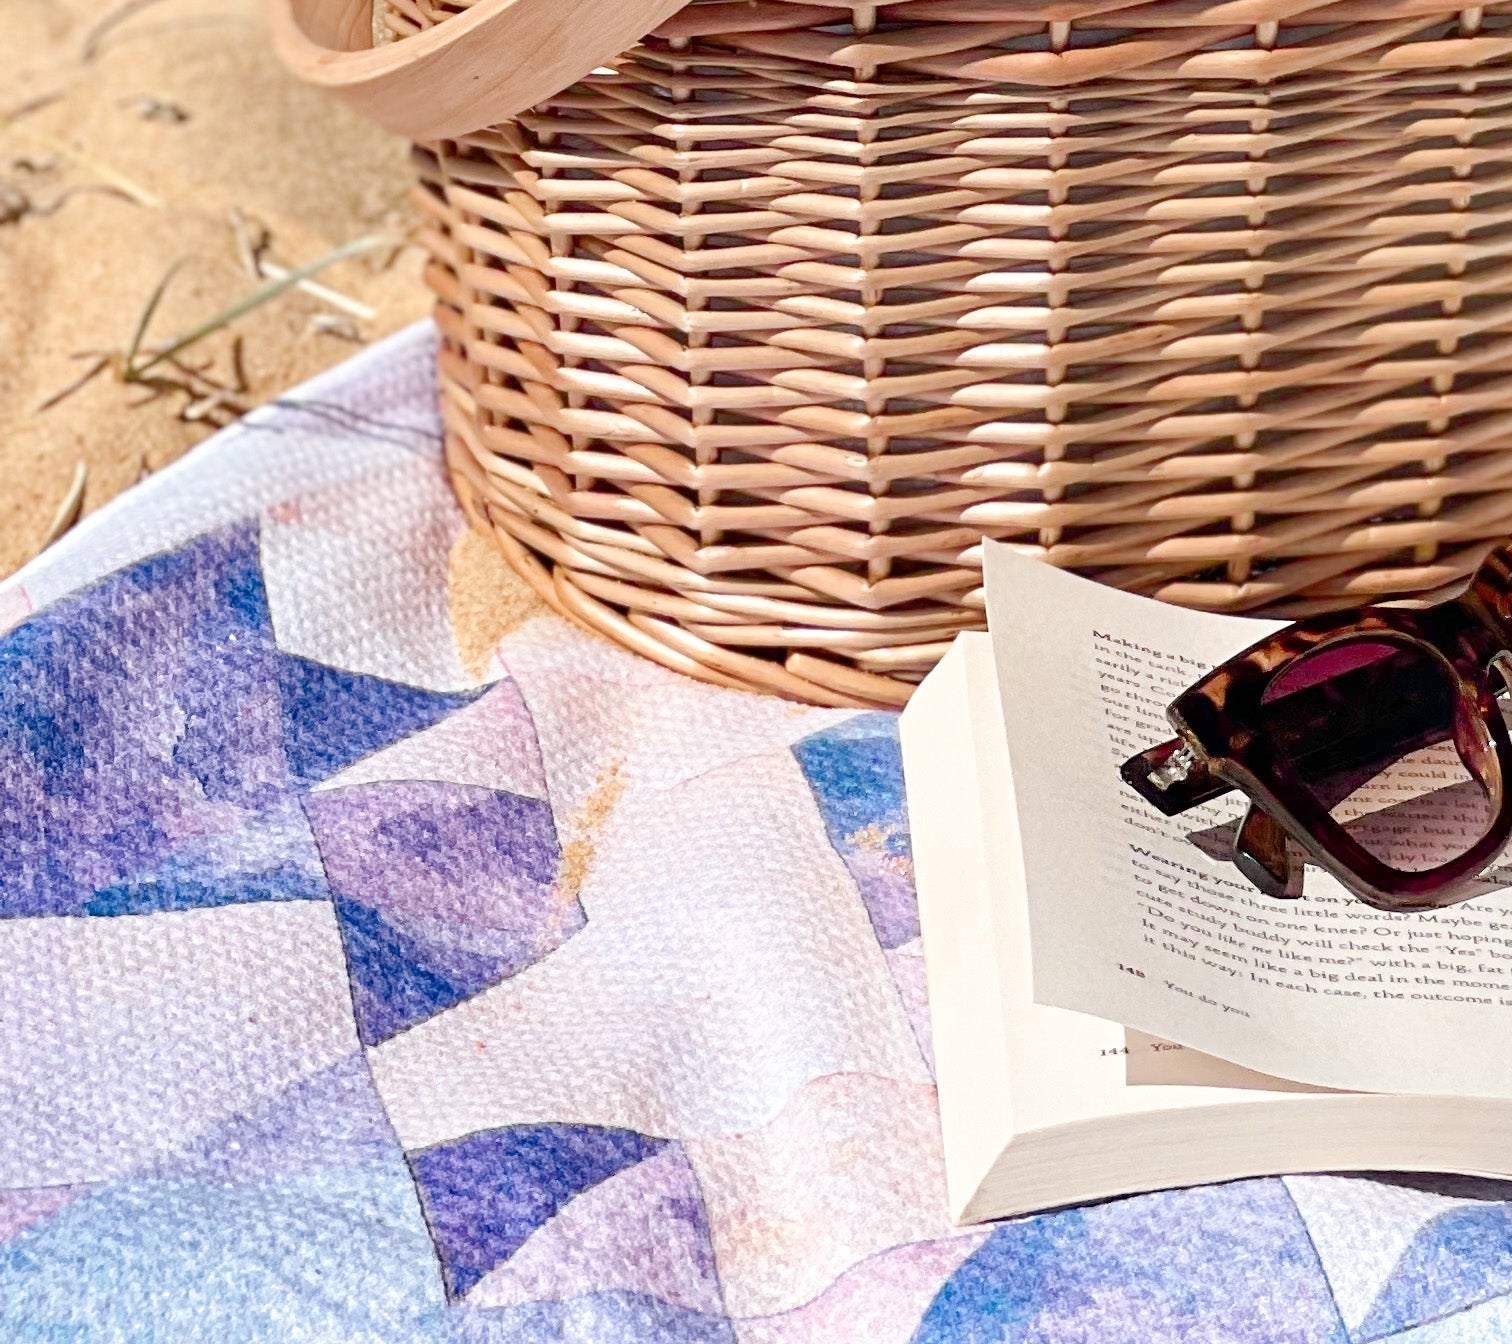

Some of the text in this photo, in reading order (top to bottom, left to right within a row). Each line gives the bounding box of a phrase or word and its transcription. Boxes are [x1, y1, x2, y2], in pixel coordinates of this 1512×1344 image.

[1092, 629, 1162, 657] Making
[1178, 653, 1207, 670] big
[1129, 843, 1208, 881] Wearing
[1212, 876, 1255, 893] your
[1314, 895, 1338, 903] on
[1461, 902, 1493, 913] Are
[1132, 859, 1150, 871] to
[1155, 868, 1181, 884] say
[1188, 877, 1235, 902] those
[1240, 898, 1288, 914] three
[1294, 906, 1338, 920] little
[1345, 912, 1411, 923] words?
[1419, 914, 1483, 928] Maybe
[1134, 874, 1153, 885] to
[1158, 884, 1185, 898] get
[1190, 894, 1242, 918] down
[1247, 914, 1270, 925] on
[1275, 922, 1309, 932] one
[1314, 925, 1368, 937] knee?
[1374, 927, 1401, 937] Or
[1407, 928, 1442, 940] just
[1136, 889, 1173, 908] cute
[1178, 904, 1228, 930] study
[1233, 923, 1290, 945] buddy
[1296, 936, 1333, 949] will
[1339, 940, 1393, 953] check
[1399, 943, 1430, 954] the
[1436, 945, 1483, 957] "Yes"
[1142, 917, 1157, 930] It
[1162, 928, 1199, 948] may
[1204, 945, 1248, 964] seem
[1254, 957, 1288, 973] like
[1309, 967, 1340, 983] big
[1345, 972, 1384, 984] deal
[1390, 974, 1408, 984] in
[1414, 974, 1446, 986] the
[1180, 921, 1213, 938] you
[1218, 933, 1246, 950] like
[1252, 945, 1273, 954] me
[1279, 949, 1310, 963] like
[1369, 957, 1416, 969] with
[1478, 964, 1505, 976] fat
[1143, 933, 1157, 945] it
[1162, 942, 1197, 962] this
[1250, 973, 1270, 985] In
[1276, 977, 1318, 994] each
[1323, 987, 1368, 999] case,
[1373, 988, 1405, 1000] the
[1411, 991, 1493, 1005] outcome
[1499, 996, 1512, 1006] is
[1163, 980, 1194, 998] You
[1199, 994, 1218, 1007] do
[1221, 1002, 1251, 1018] you
[1150, 1042, 1183, 1052] You
